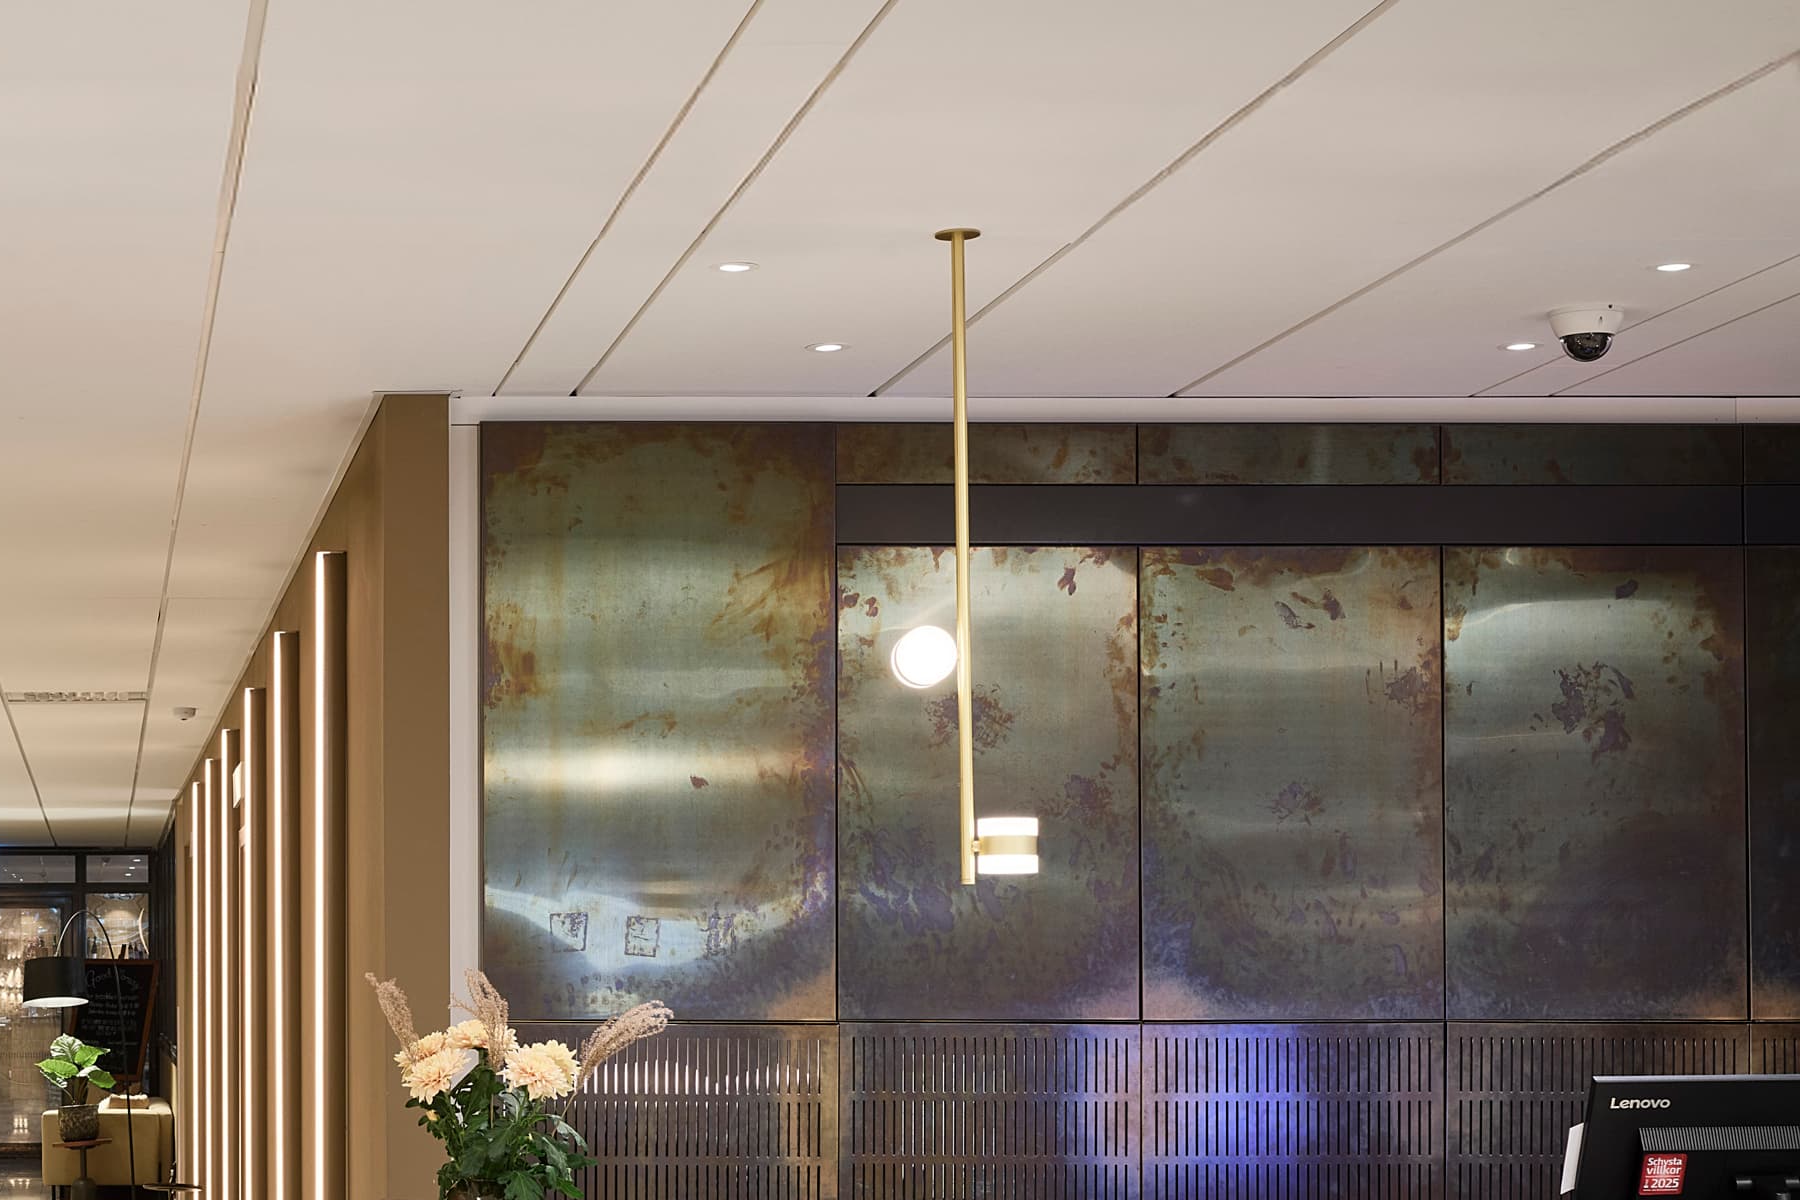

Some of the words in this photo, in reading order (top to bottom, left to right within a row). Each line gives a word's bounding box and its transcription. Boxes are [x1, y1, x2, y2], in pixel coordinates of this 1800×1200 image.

[1610, 1097, 1671, 1109] Lenovo
[1647, 1157, 1682, 1166] Schysta
[1646, 1165, 1682, 1175] villkor
[1650, 1178, 1680, 1188] 2025
